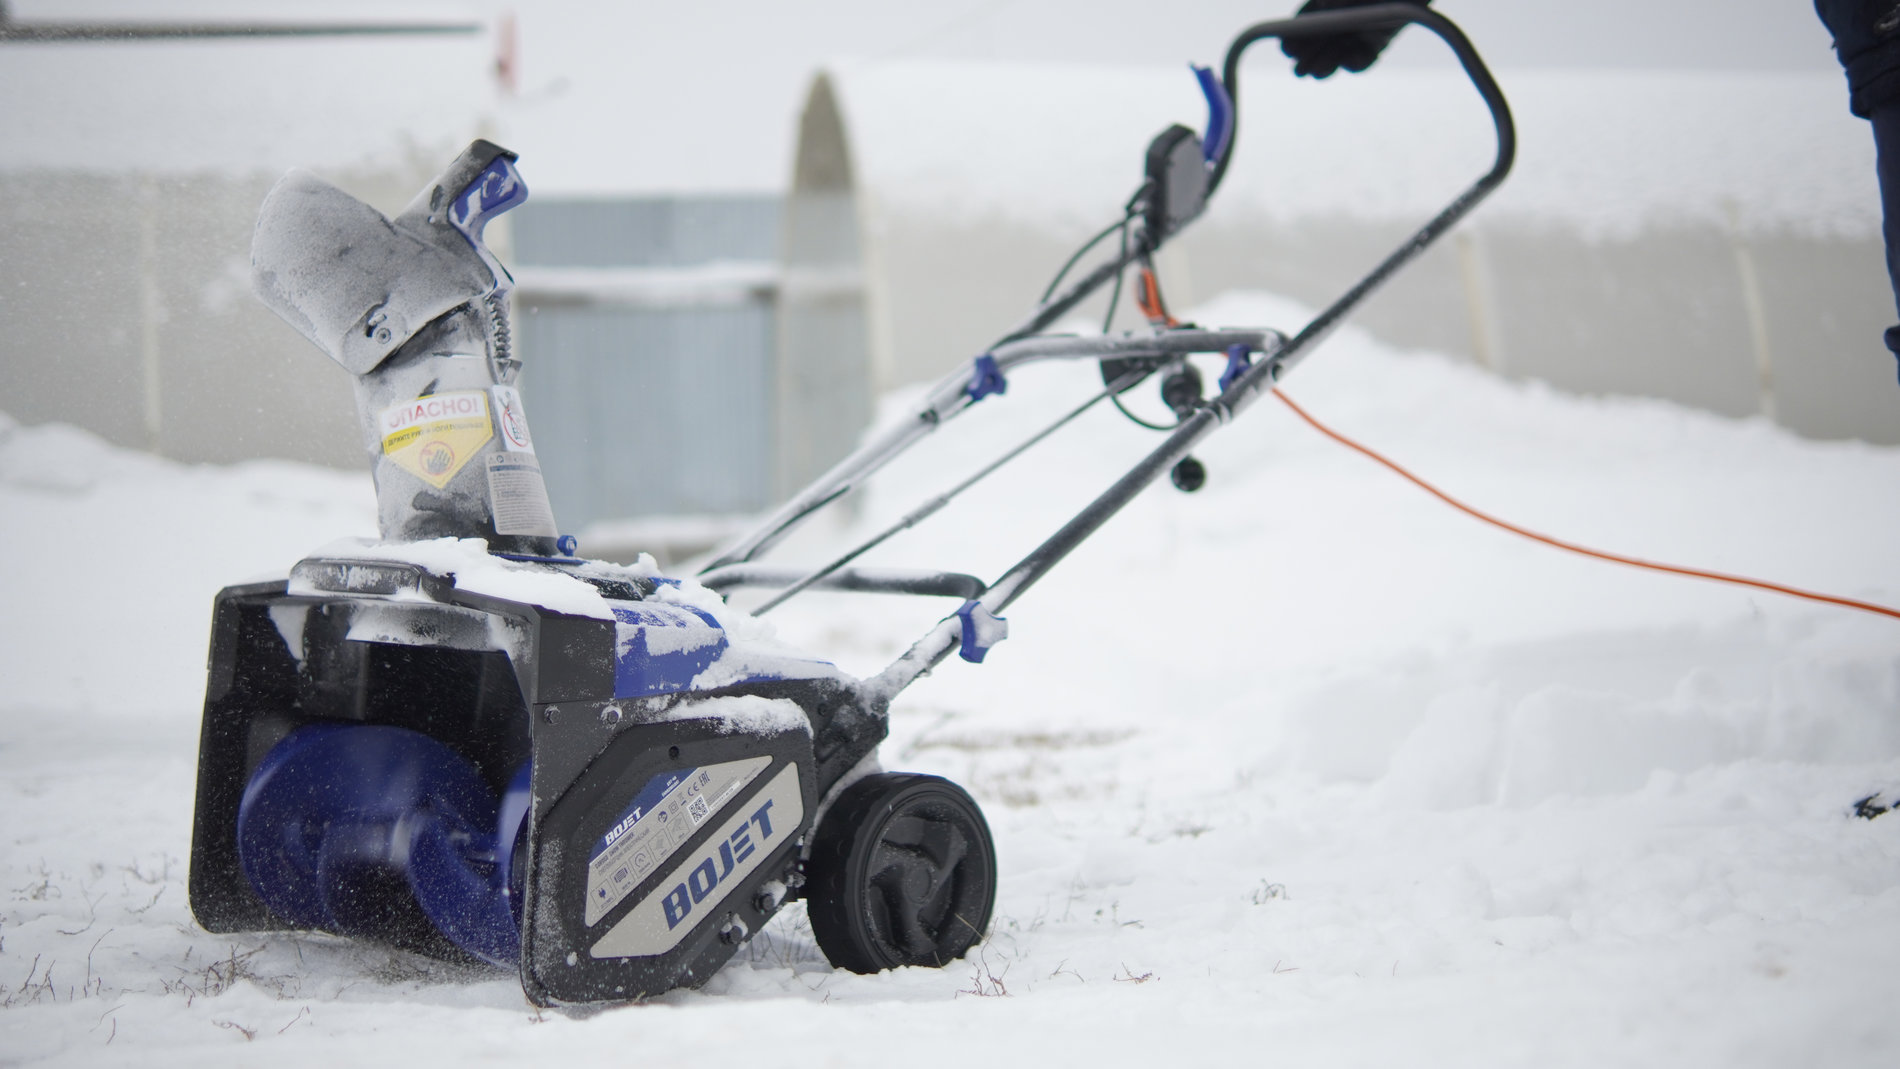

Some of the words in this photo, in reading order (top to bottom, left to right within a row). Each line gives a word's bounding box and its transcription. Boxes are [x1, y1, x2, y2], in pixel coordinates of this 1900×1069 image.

[389, 397, 479, 429] ОПАСНО!
[605, 807, 641, 846] BOJET
[661, 799, 773, 931] BOJET
